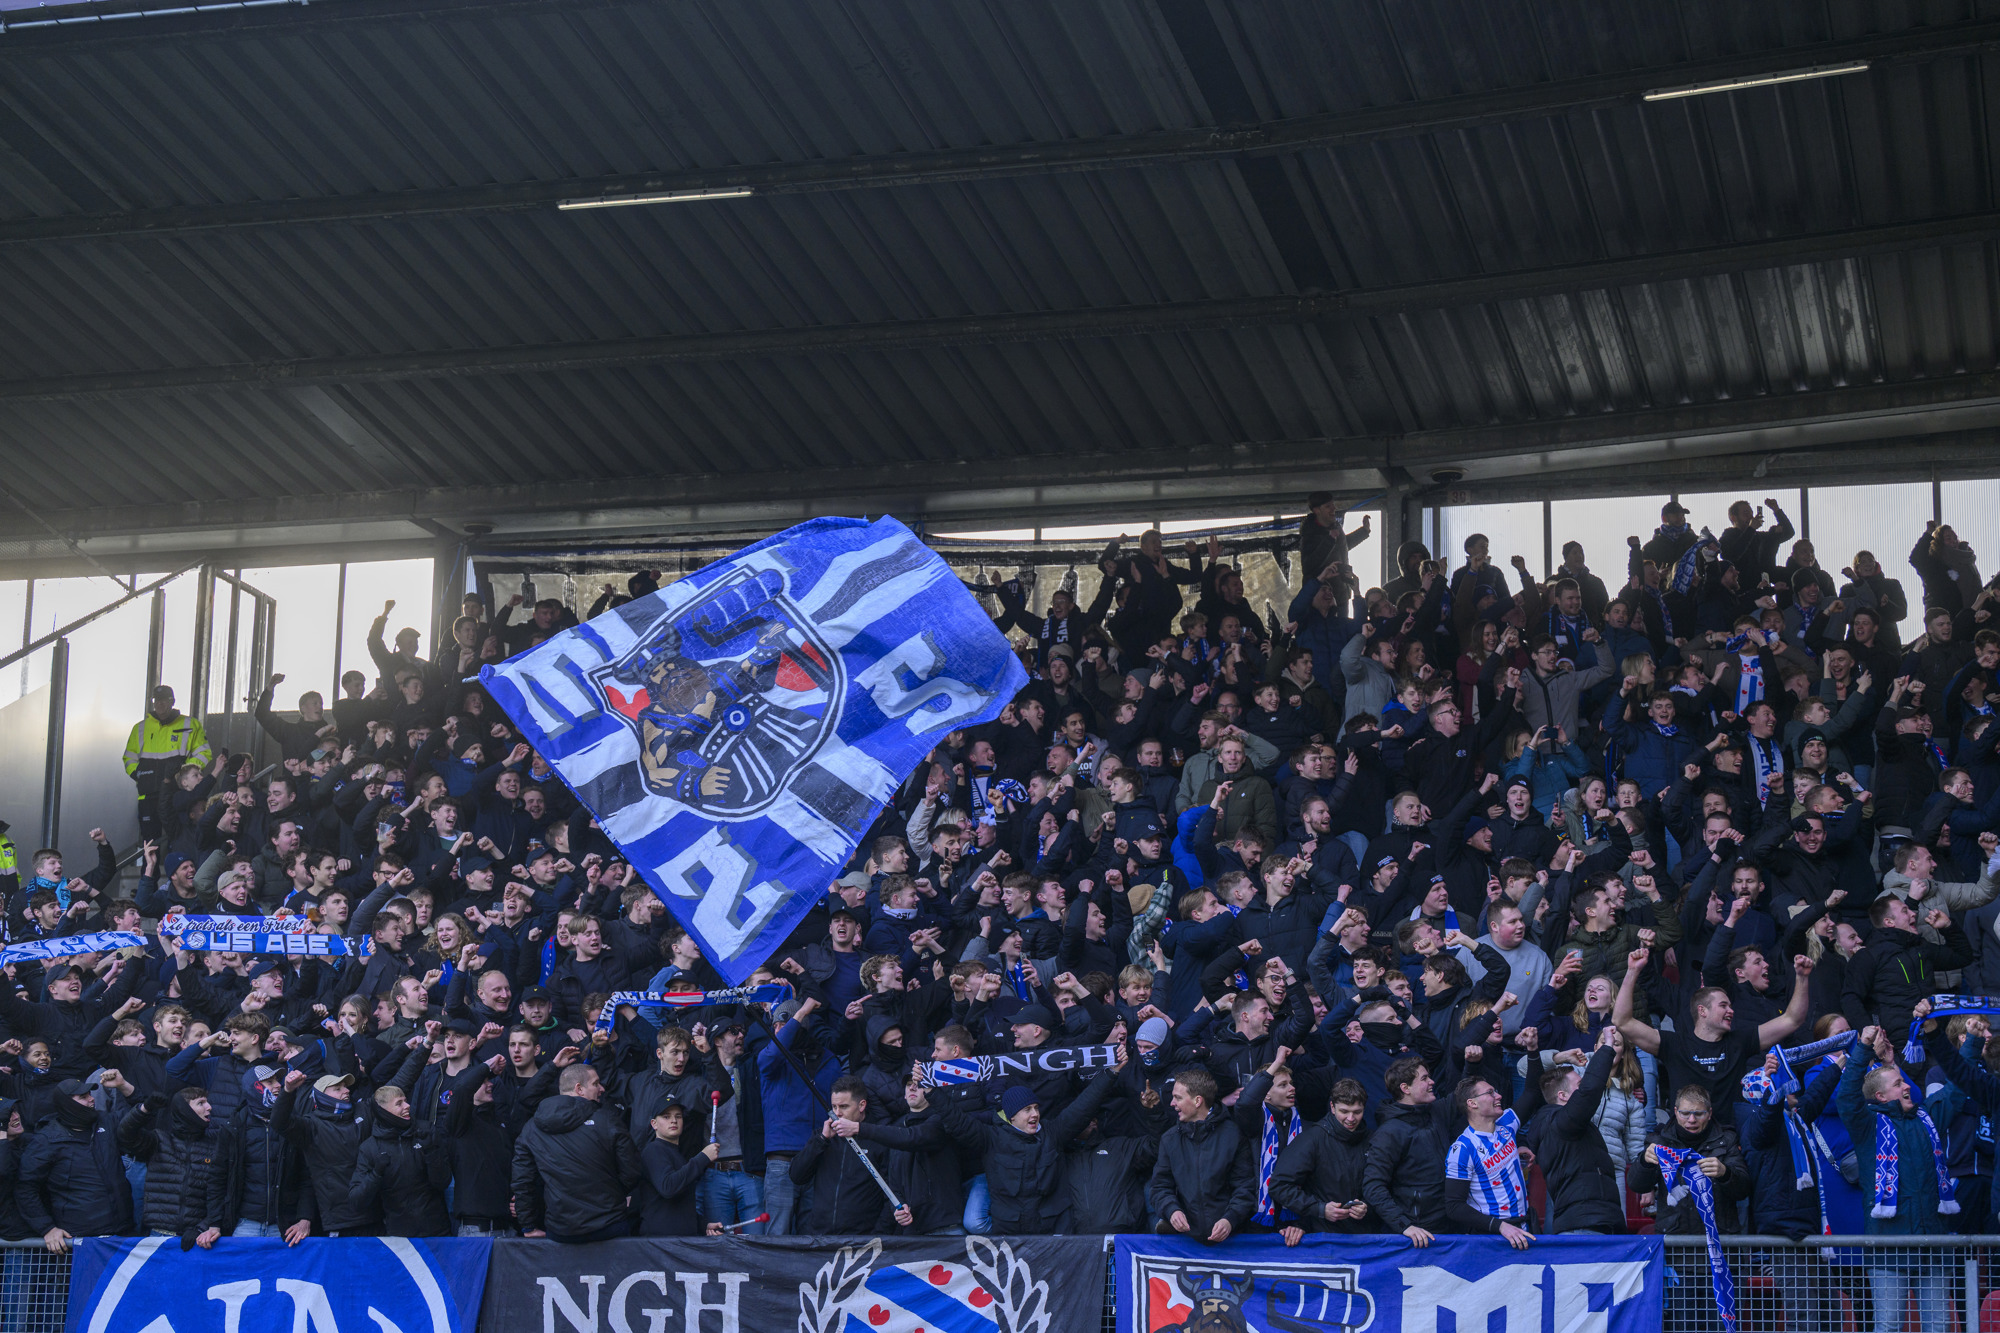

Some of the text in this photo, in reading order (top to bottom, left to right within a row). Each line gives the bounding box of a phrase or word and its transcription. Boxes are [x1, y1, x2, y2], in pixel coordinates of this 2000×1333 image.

[186, 917, 215, 932] trots
[215, 917, 238, 932] als
[237, 921, 260, 932] een
[261, 916, 306, 934] Fries!
[265, 933, 330, 954] ABE
[995, 1043, 1120, 1077] NGH
[1483, 1139, 1517, 1170] WOLKOM
[537, 1270, 750, 1333] NGH
